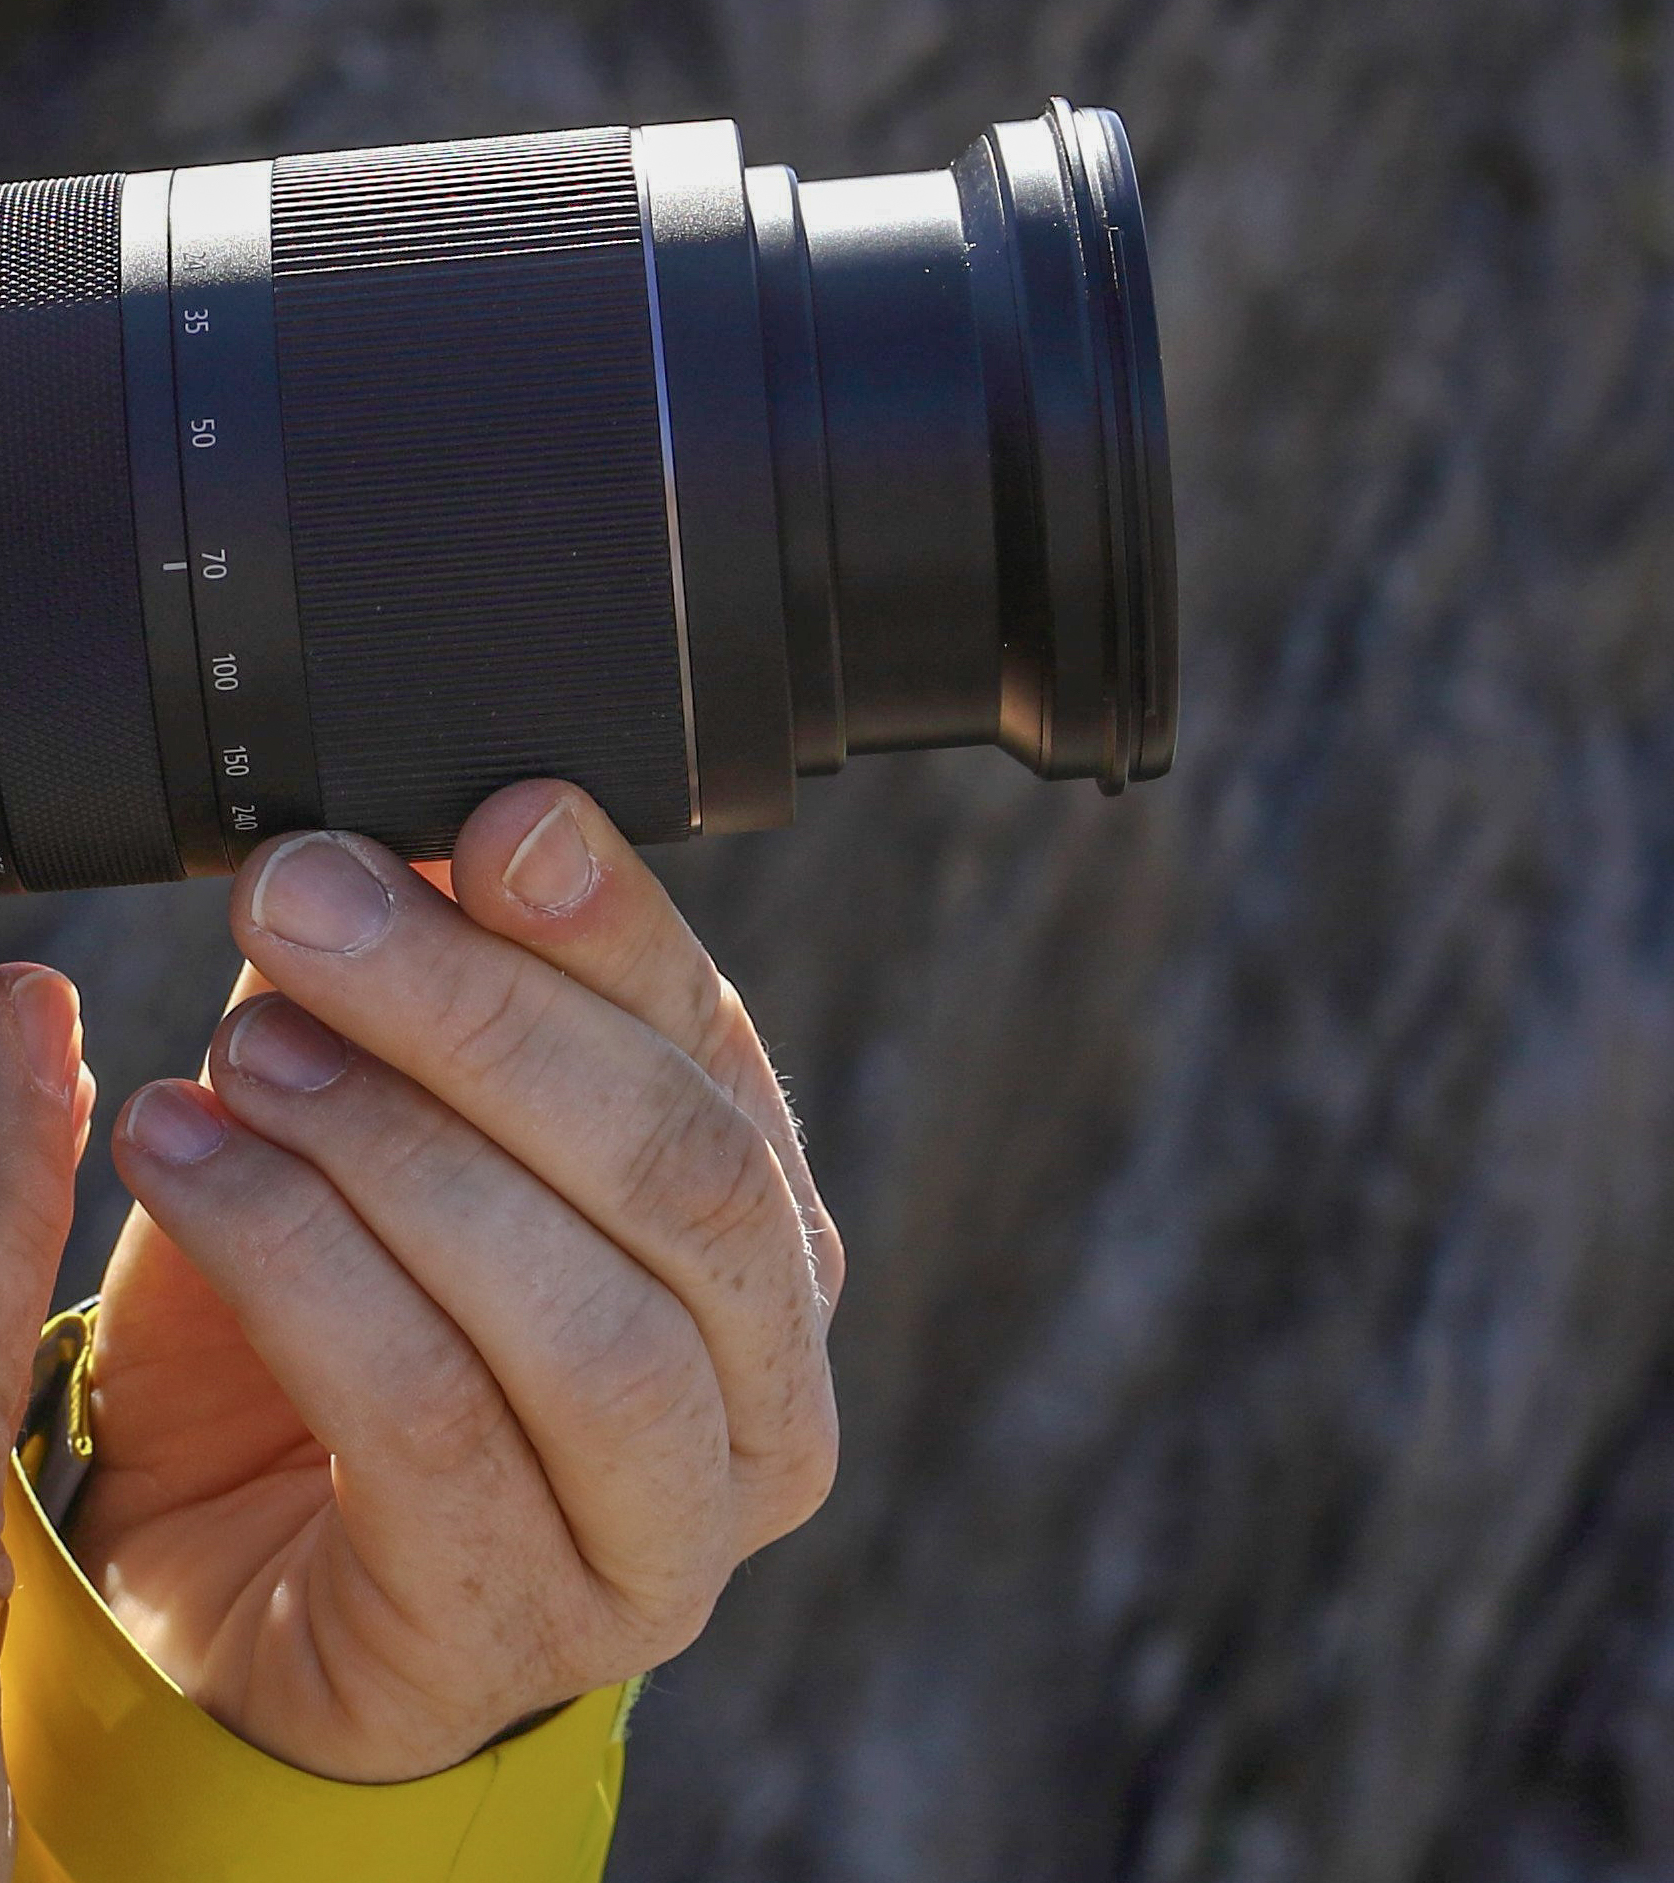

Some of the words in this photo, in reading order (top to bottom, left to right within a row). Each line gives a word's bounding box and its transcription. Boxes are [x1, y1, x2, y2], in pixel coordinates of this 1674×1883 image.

[184, 308, 209, 334] 35
[191, 418, 216, 448] 50
[201, 549, 227, 580] 70
[212, 653, 239, 691] 100
[223, 745, 250, 777] 150
[231, 804, 258, 831] 240
